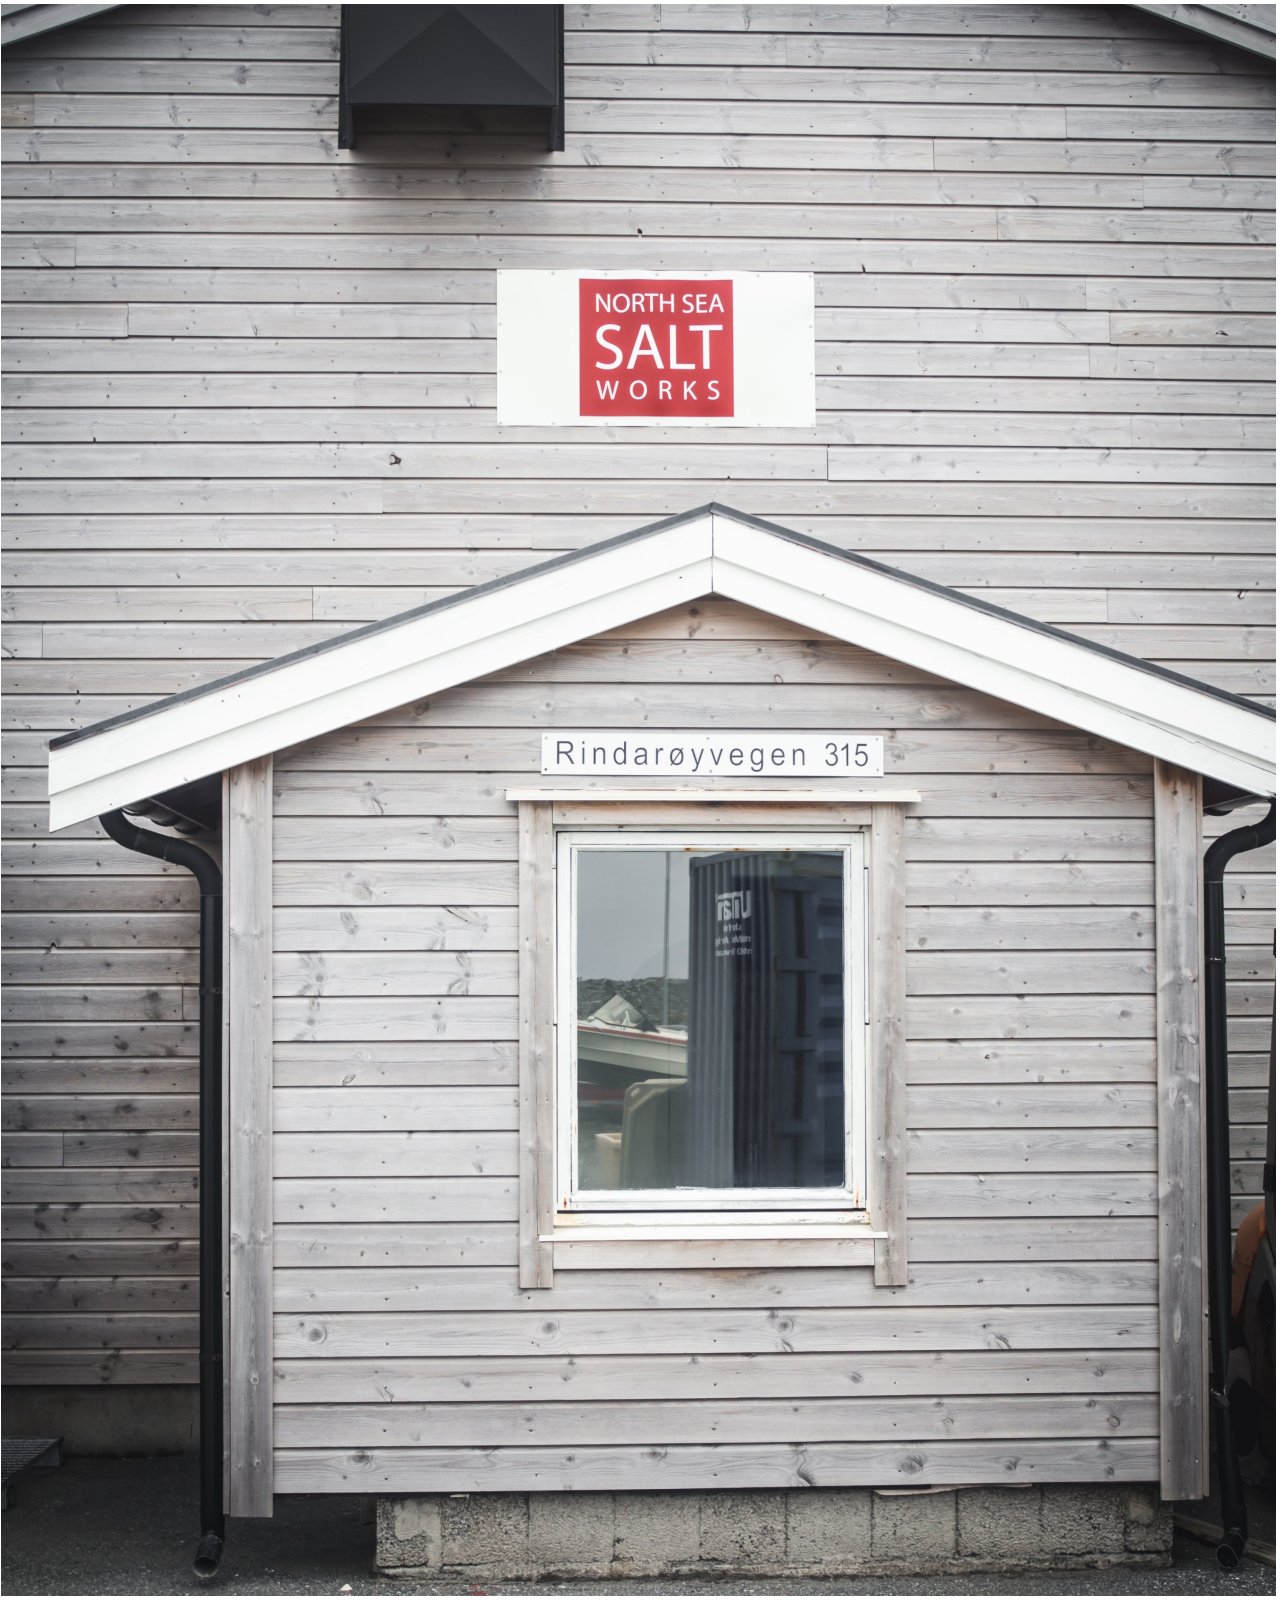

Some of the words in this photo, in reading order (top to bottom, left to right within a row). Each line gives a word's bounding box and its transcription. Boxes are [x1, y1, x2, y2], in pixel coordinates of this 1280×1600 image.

[595, 292, 675, 314] NORTH
[681, 293, 725, 314] SEA
[595, 323, 724, 370] SALT
[595, 379, 721, 401] WORKS
[556, 740, 806, 773] Rindarøyvegen
[825, 742, 869, 767] 315
